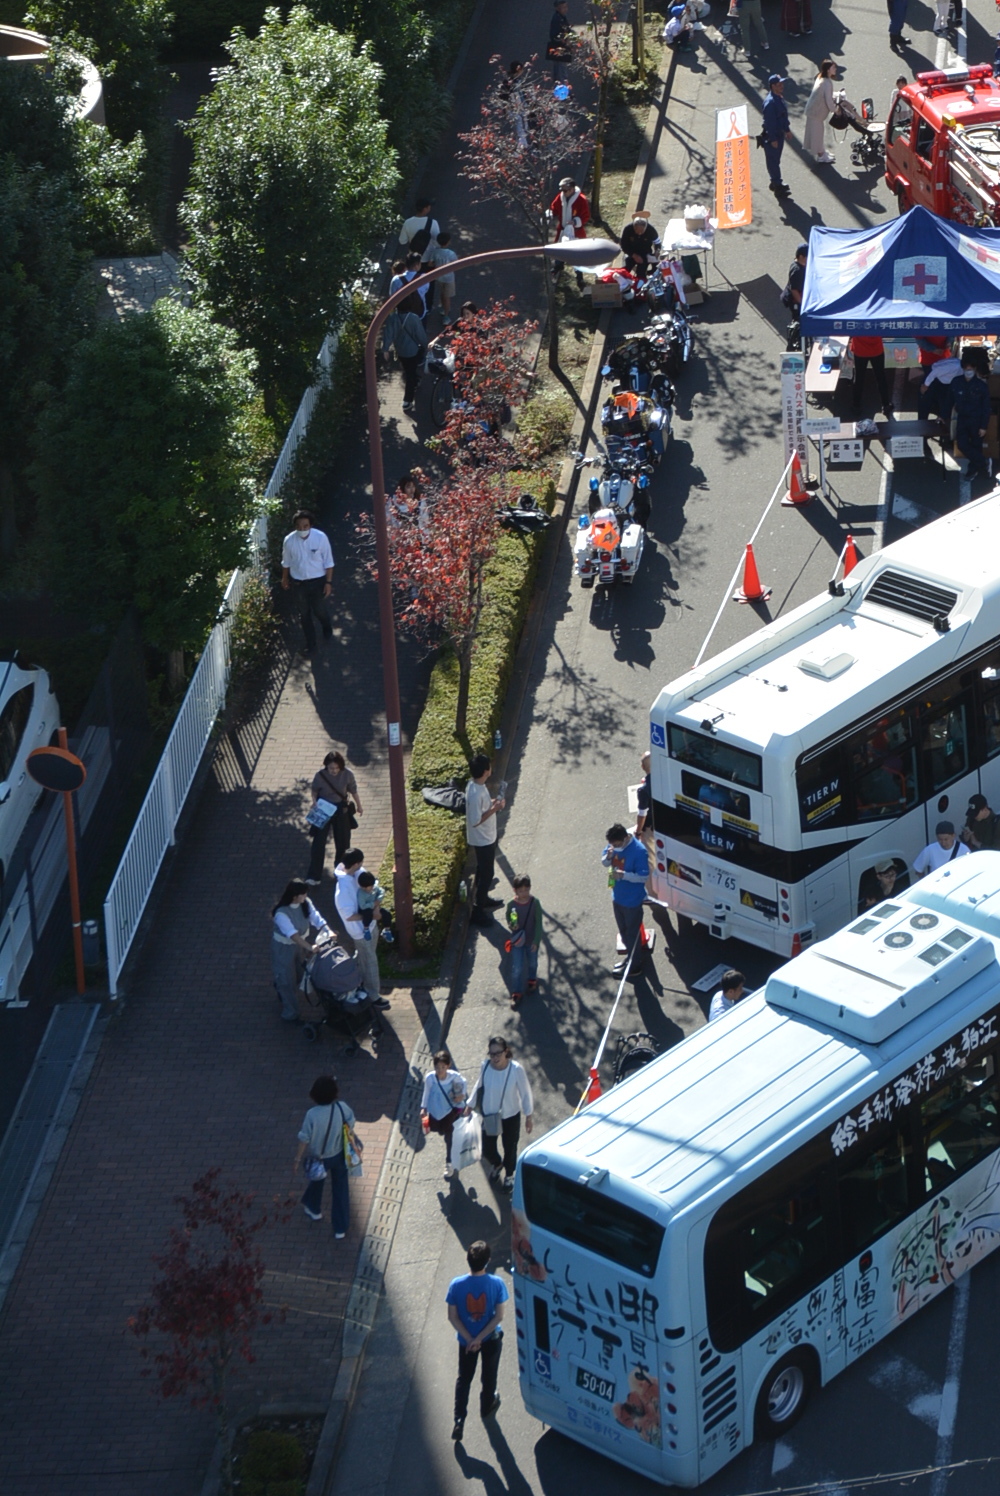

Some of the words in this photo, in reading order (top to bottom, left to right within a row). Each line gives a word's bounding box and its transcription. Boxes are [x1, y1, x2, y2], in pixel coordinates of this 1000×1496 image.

[738, 139, 747, 201] オレンジリボン
[807, 786, 829, 806] TIER
[700, 830, 724, 848] TIER
